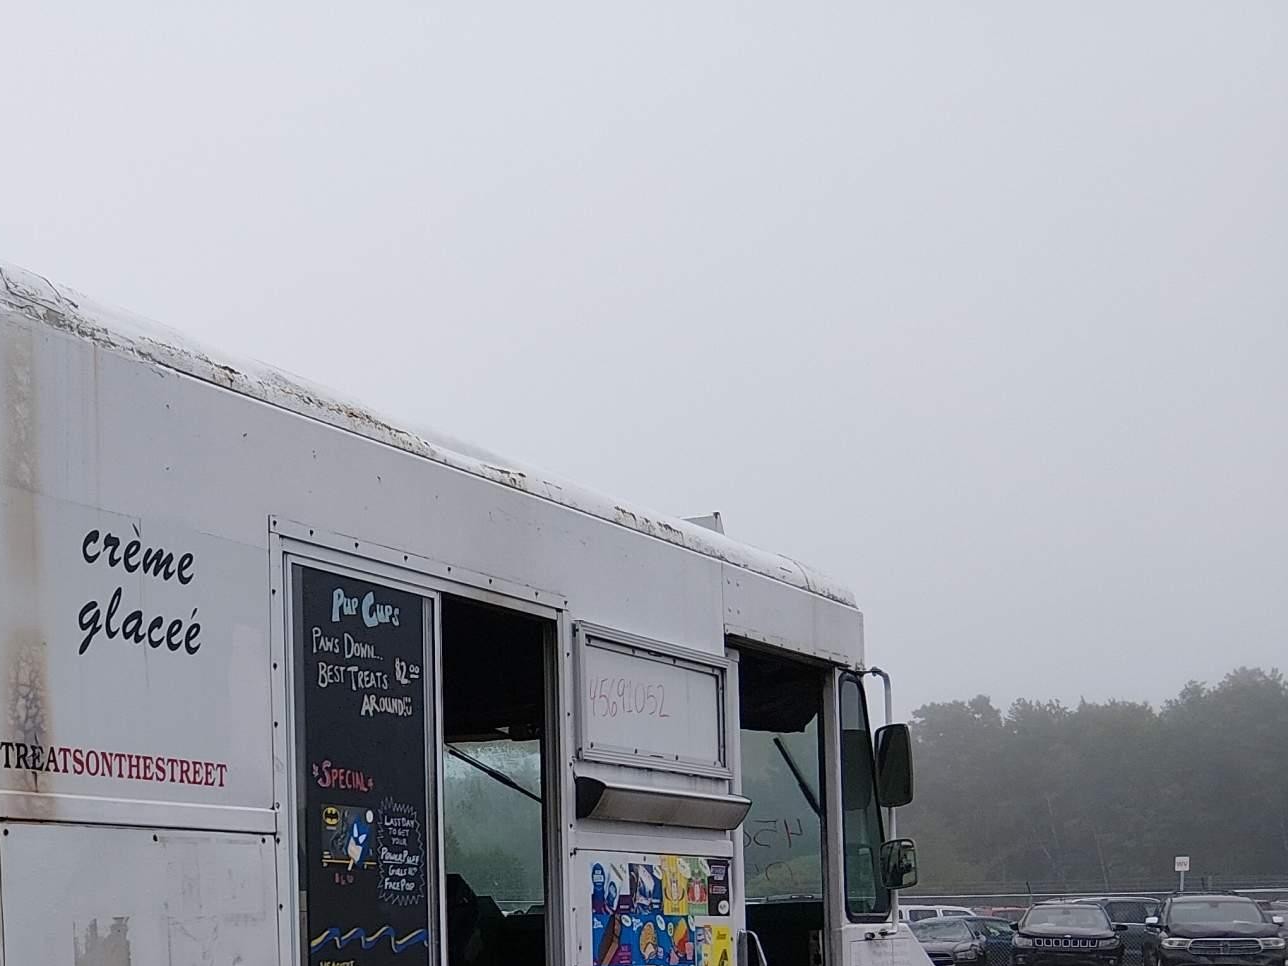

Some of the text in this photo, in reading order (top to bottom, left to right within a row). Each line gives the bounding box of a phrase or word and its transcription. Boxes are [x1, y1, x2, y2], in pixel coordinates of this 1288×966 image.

[82, 523, 194, 585] crème
[78, 587, 201, 655] glaceé
[318, 662, 388, 691] BEST TREATS
[589, 678, 671, 718] 45691052
[0, 741, 227, 787] TREATSONTHESTREET
